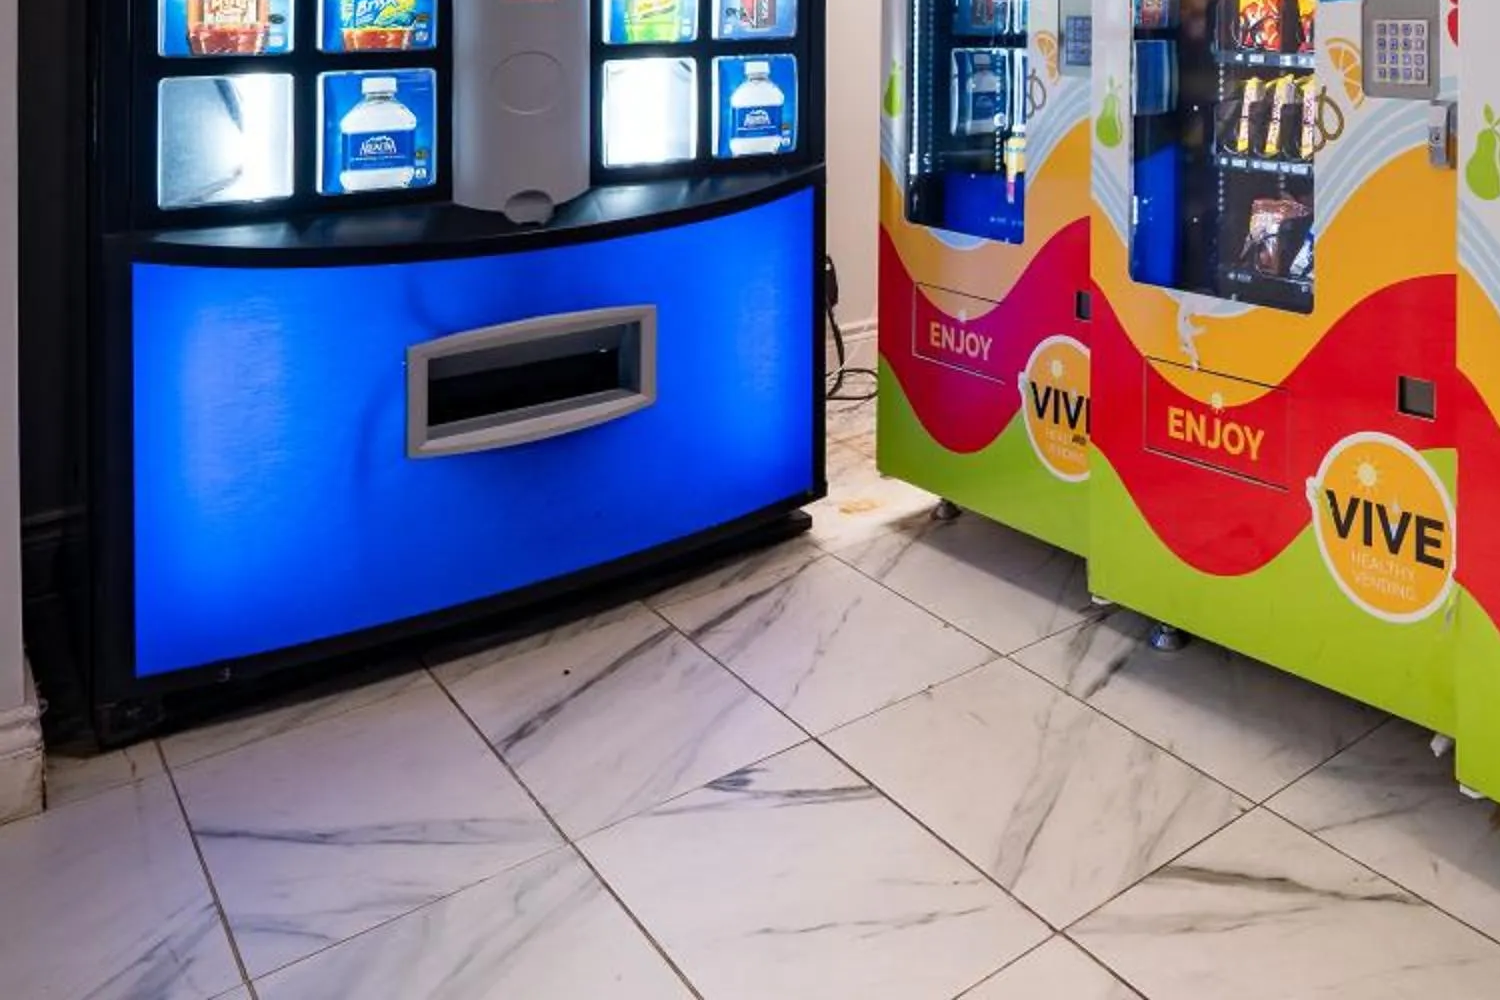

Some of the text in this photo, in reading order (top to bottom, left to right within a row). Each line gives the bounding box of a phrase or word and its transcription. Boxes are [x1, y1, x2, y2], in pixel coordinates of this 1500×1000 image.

[929, 320, 993, 361] ENJOY
[1030, 381, 1090, 435] VIV
[1167, 405, 1265, 461] ENJOY
[1325, 488, 1445, 570] VIVE
[1350, 549, 1416, 582] HEALTHY
[1353, 574, 1417, 602] VENDING
